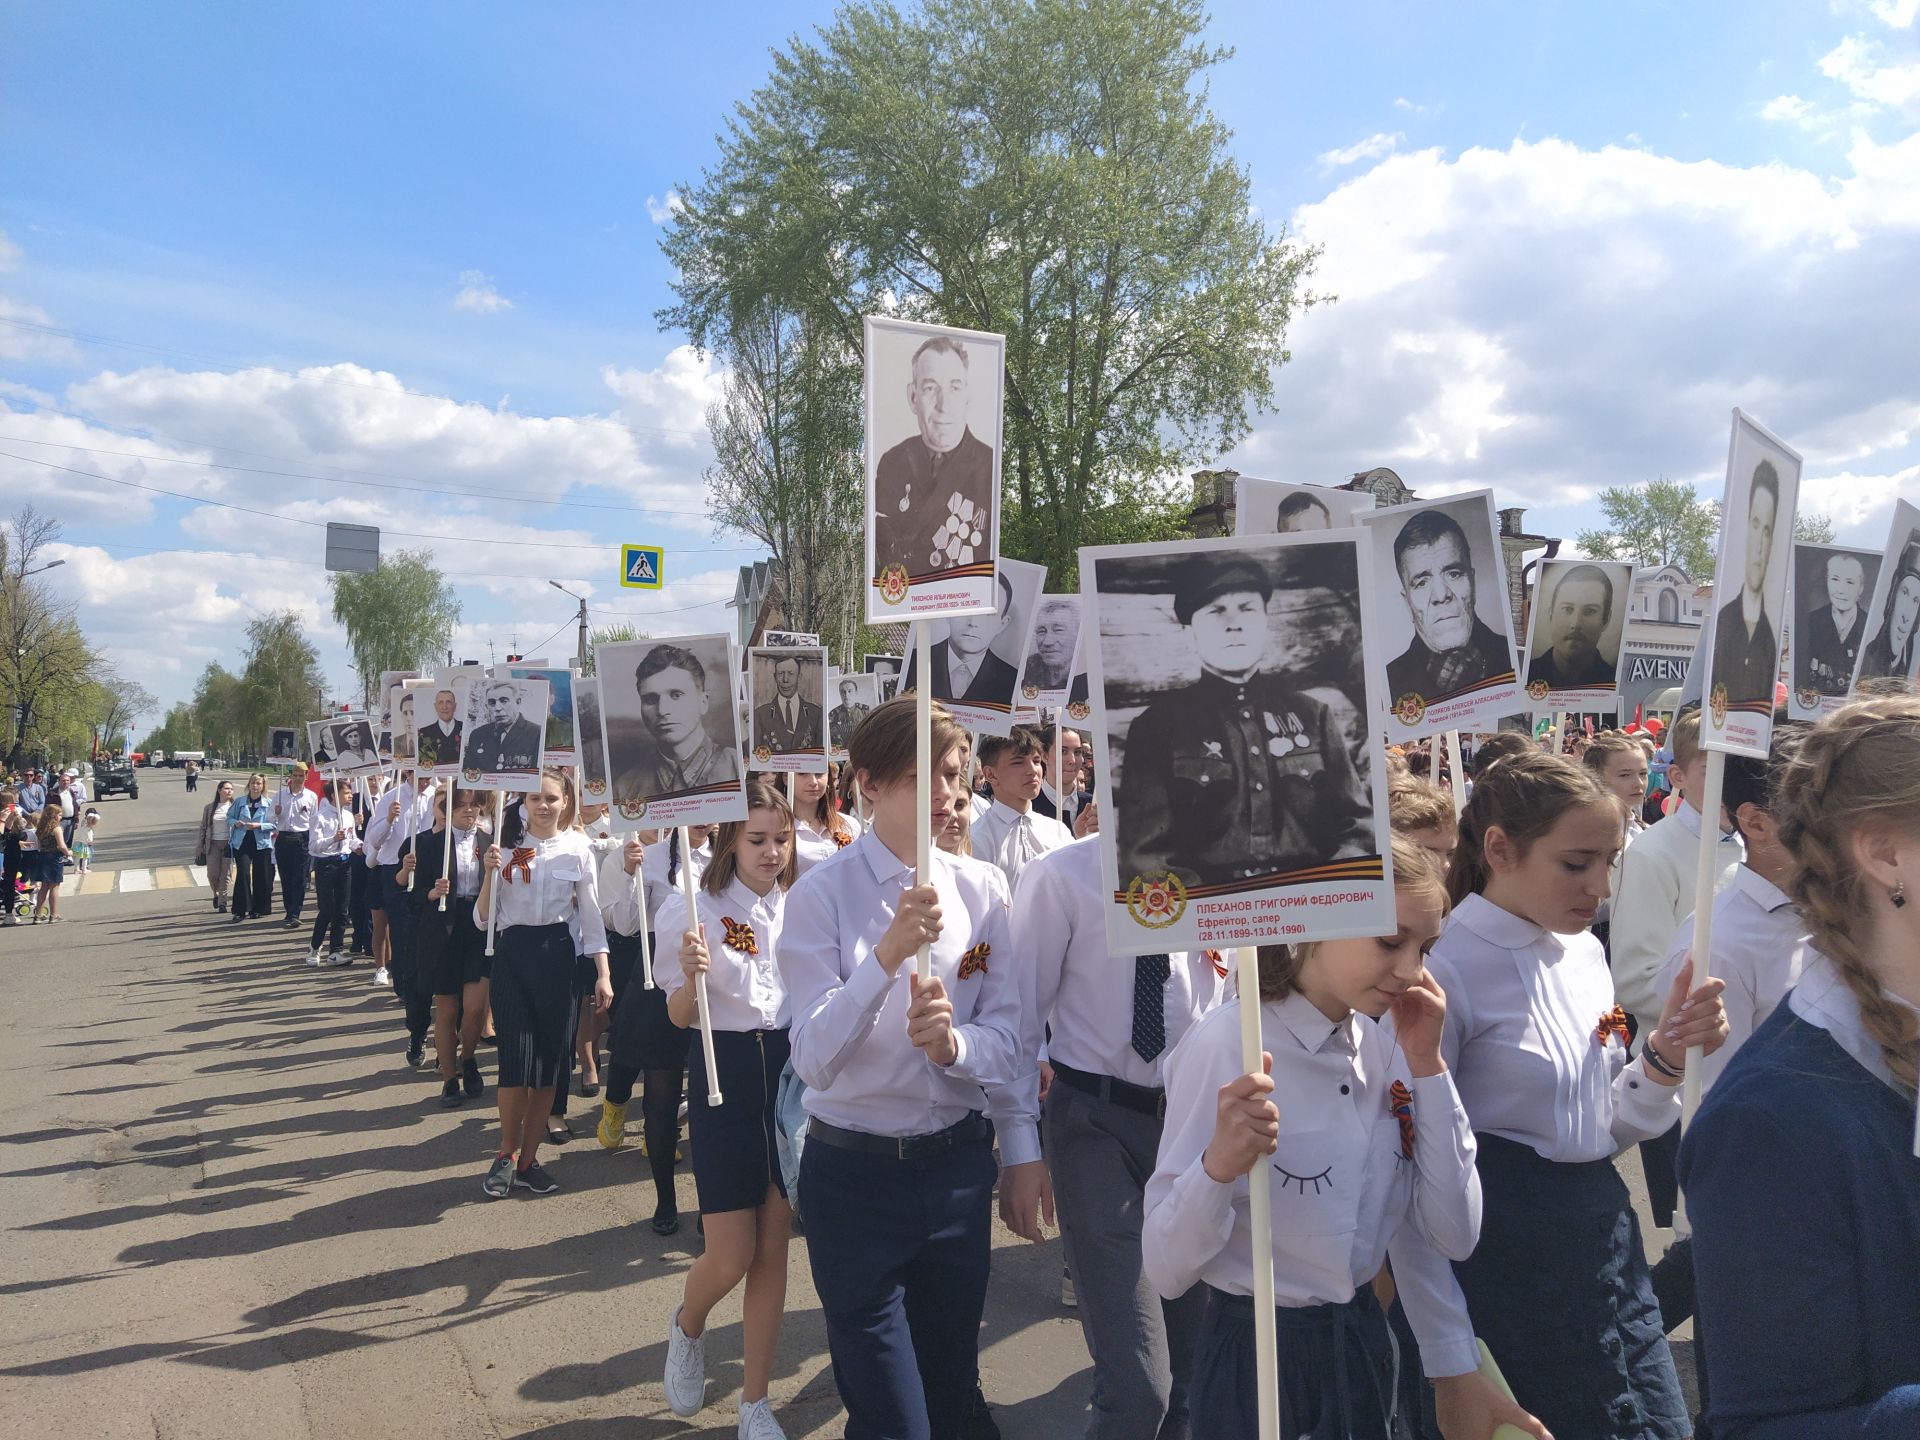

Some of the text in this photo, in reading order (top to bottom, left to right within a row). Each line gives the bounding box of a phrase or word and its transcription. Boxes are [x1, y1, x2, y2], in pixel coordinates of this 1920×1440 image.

[911, 591, 971, 603] ТИХОНОВ ИЛЬЯ ИВАНОВИЧ
[1426, 689, 1516, 716] ПОЛЯКОВ АЛЕКСЕЙ АЛЕКСАНДРОВИЧ
[1428, 715, 1449, 724] Рядовой
[648, 795, 736, 809] КАРПОВ ВЛАДИМИР ИВАНОВИЧ
[648, 805, 701, 816] Старший лейтенант
[1196, 891, 1374, 914] ПЛЕХАНОВ ГРИГОРИЙ ФЕДОРОВИЧ
[1197, 913, 1281, 929] Ефрейтор, сапер
[1198, 924, 1306, 942] (28.11.1899-13.04.1990)
